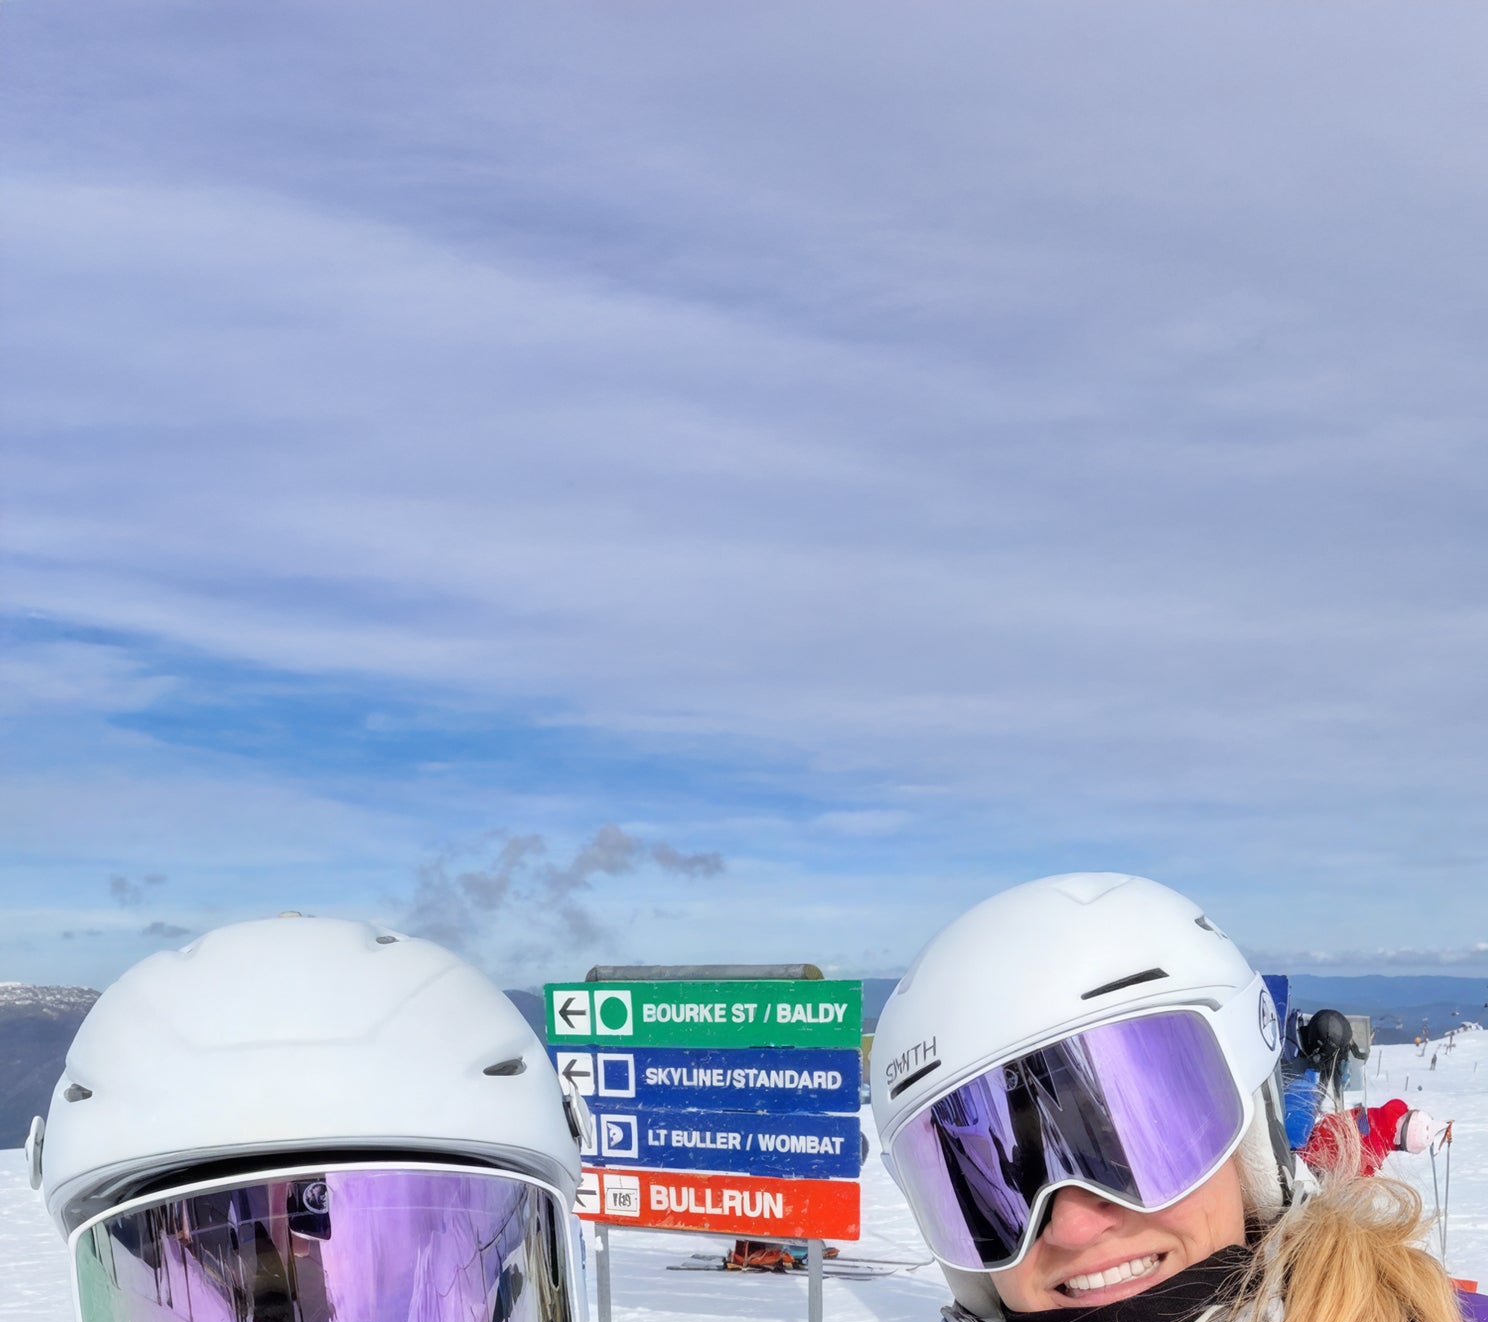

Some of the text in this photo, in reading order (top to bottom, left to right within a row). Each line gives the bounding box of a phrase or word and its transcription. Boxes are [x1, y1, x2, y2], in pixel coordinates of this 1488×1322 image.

[642, 1003, 848, 1023] BOURKE ST / BALDY
[648, 1129, 845, 1155] LT BULLER / WOMBAT
[650, 1184, 784, 1219] BULLRUN
